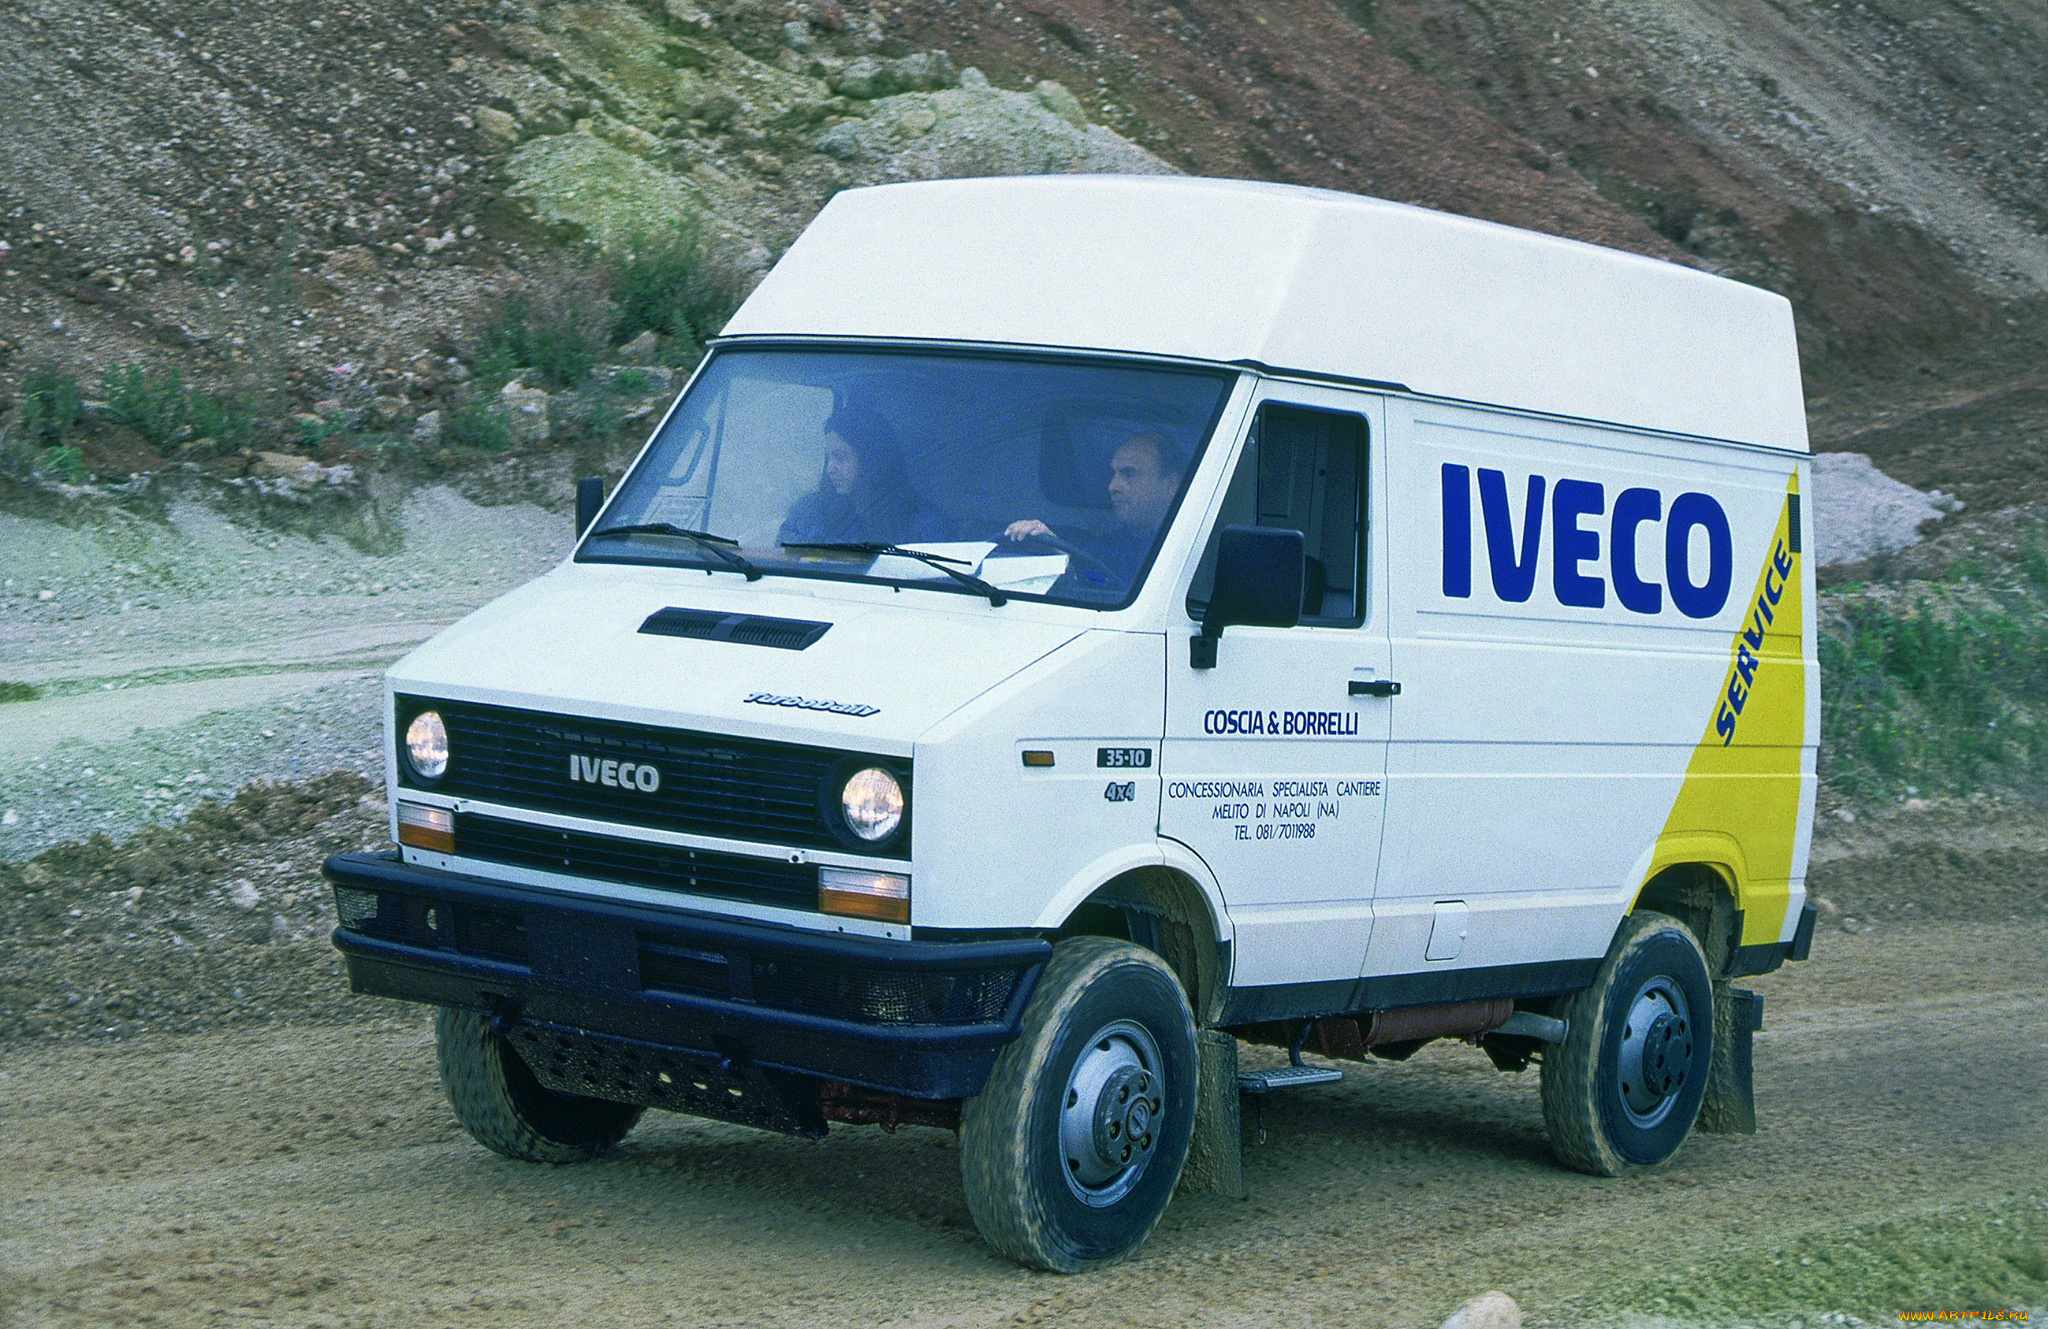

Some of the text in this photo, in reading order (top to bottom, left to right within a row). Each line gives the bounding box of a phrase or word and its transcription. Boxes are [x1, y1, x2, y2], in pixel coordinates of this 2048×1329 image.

[1441, 462, 1733, 619] IVECO
[1716, 538, 1793, 747] SERVICE
[1203, 709, 1359, 736] COSCIA & BORRELLI
[1105, 749, 1146, 767] 35-10
[569, 754, 661, 793] IVECO
[1104, 781, 1135, 802] 4x4
[1168, 781, 1381, 799] CONCESSIONARIA SPECIALISTA CANTIERE
[1212, 800, 1340, 820] MELITO DI NAPOLI (NA)
[1234, 823, 1316, 840] TEL. 081/7011988
